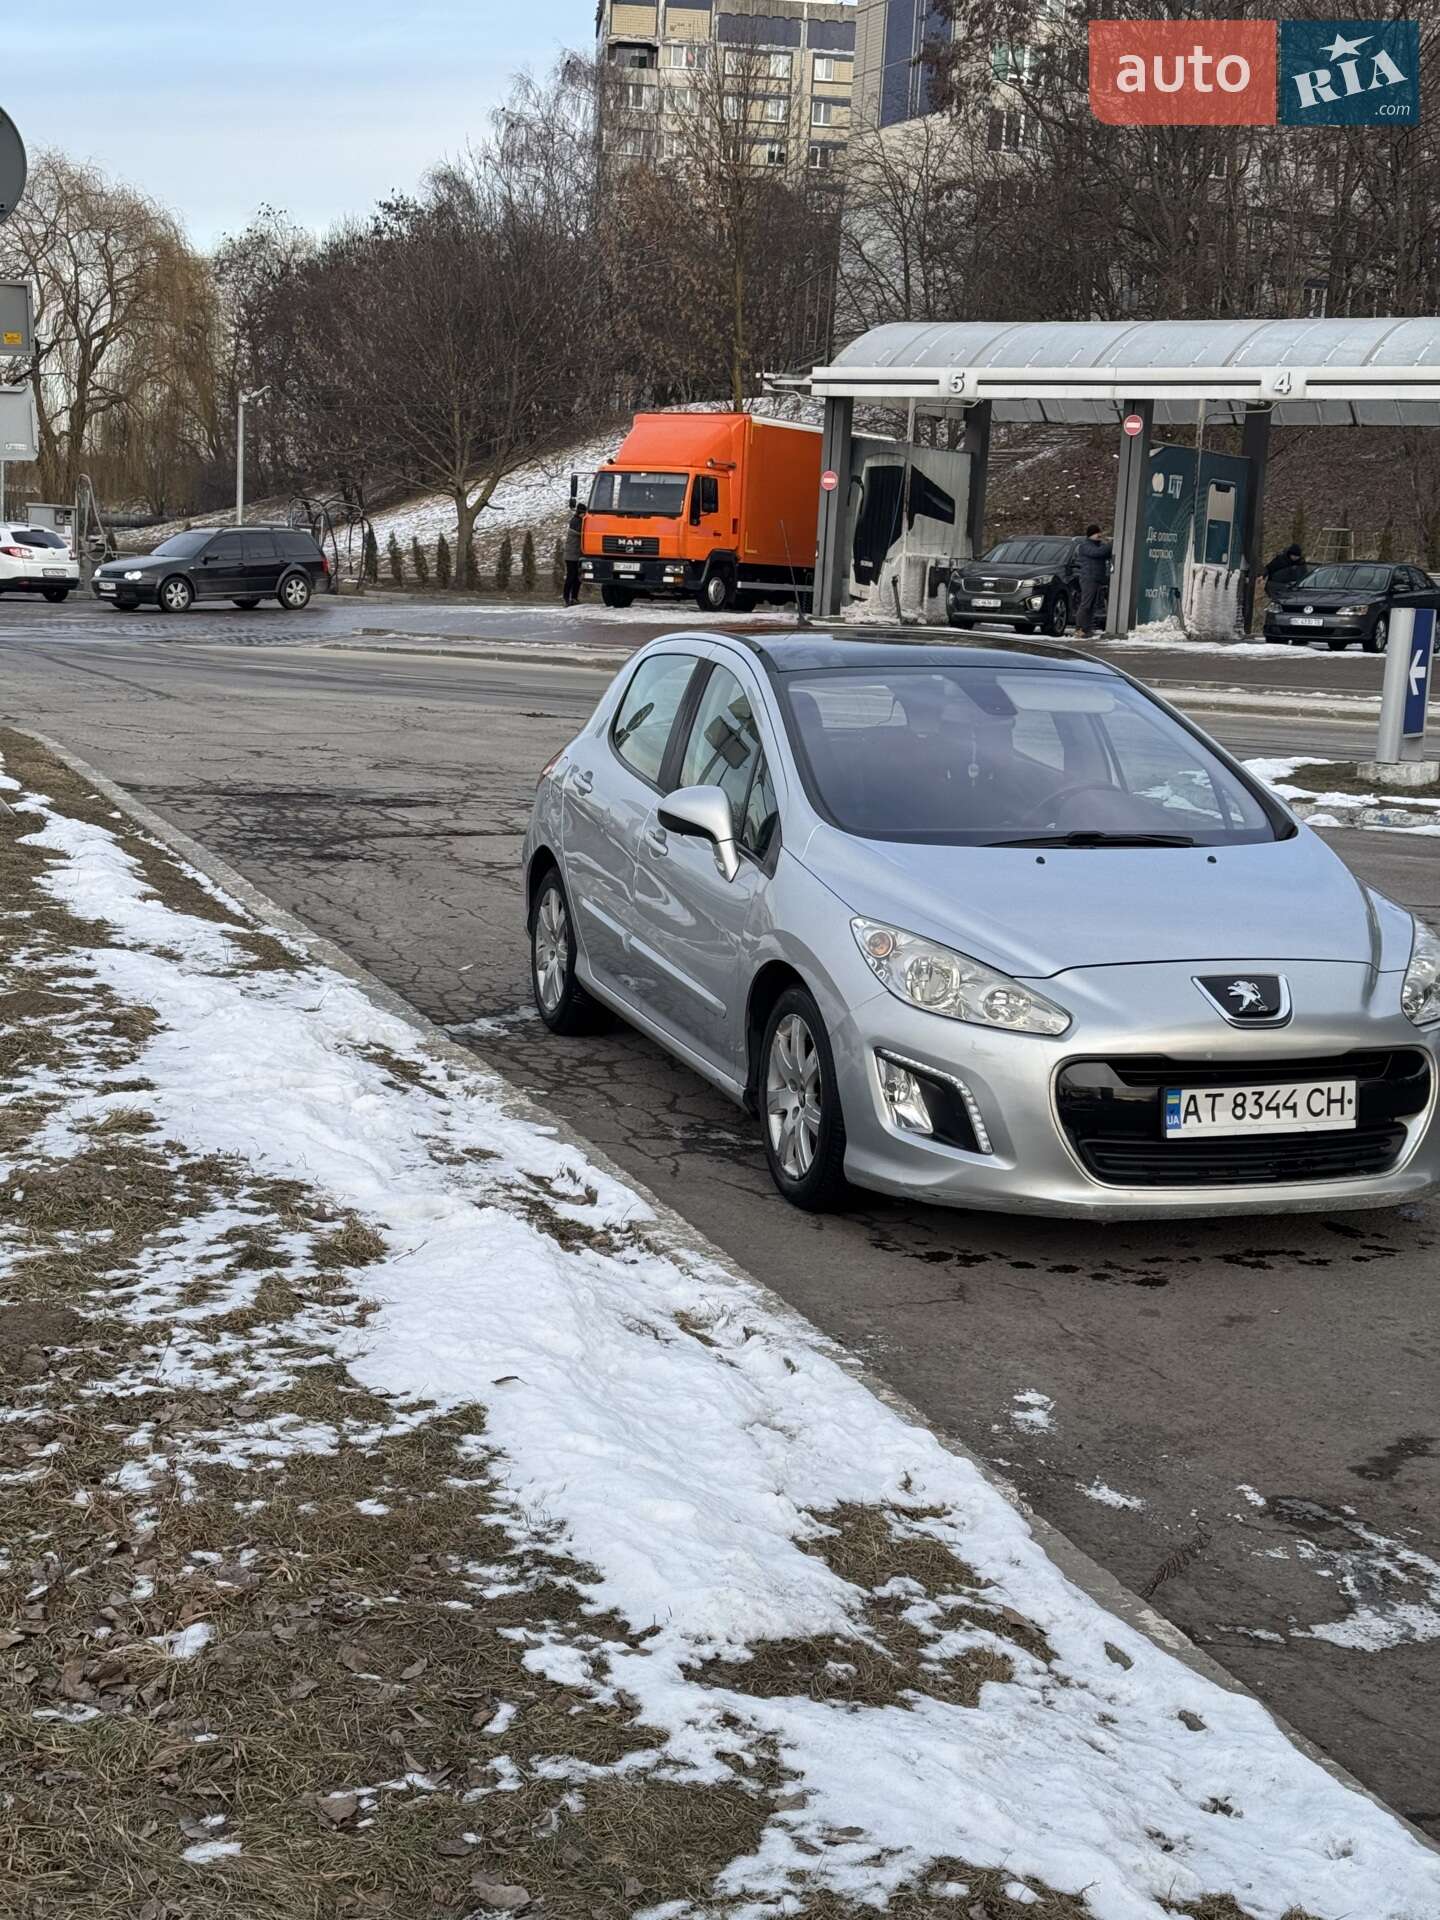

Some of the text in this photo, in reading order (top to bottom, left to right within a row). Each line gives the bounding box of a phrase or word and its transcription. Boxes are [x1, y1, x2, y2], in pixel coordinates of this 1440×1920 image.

[949, 371, 965, 393] 5
[1272, 372, 1291, 395] 4
[617, 538, 642, 546] MAN
[1183, 1086, 1346, 1124] AT 8344 CH
[1166, 1116, 1180, 1125] UA
